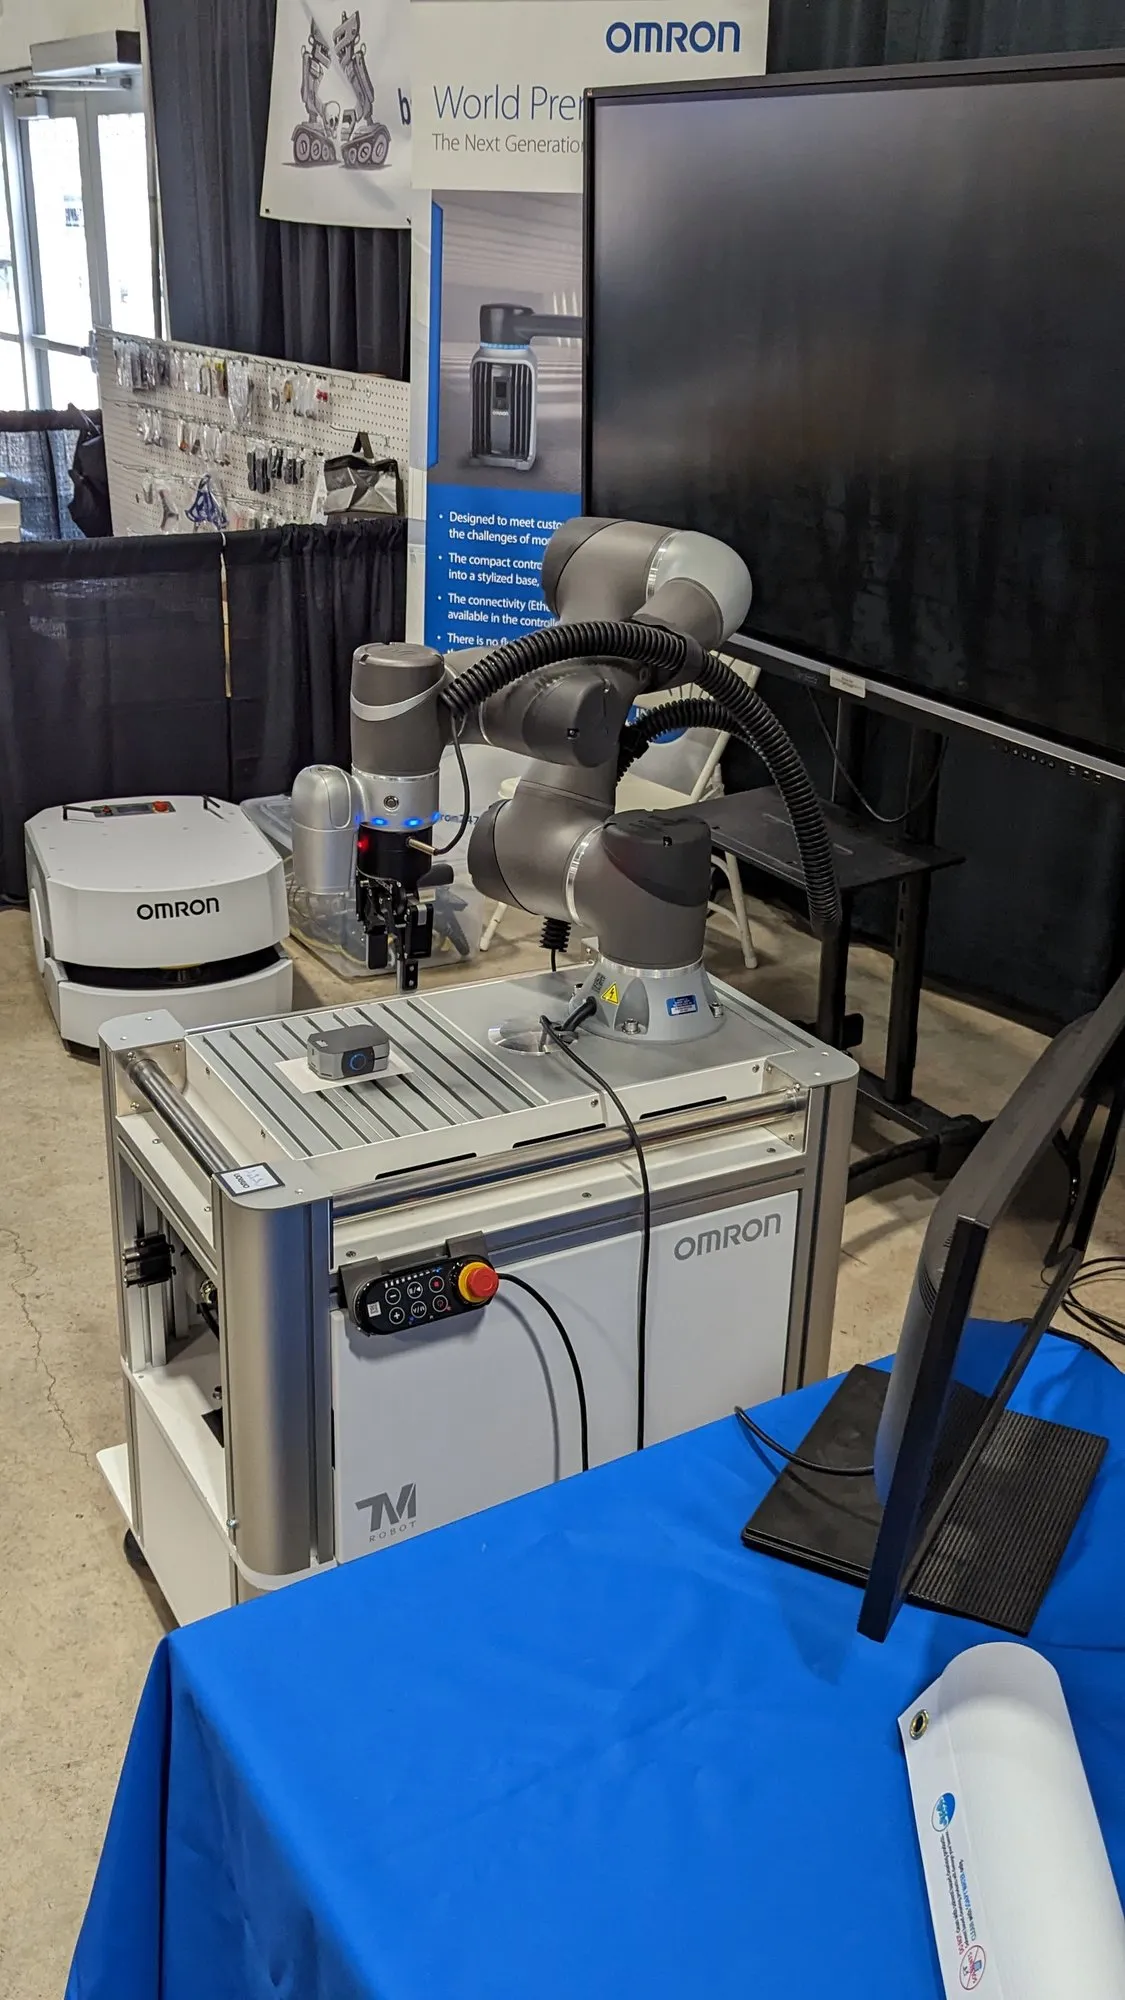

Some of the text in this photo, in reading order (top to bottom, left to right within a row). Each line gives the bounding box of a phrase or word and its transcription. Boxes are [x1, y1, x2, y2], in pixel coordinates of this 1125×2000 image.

[605, 21, 741, 54] OMRON
[433, 84, 520, 120] World
[432, 133, 460, 151] The
[465, 134, 501, 152] Next
[449, 511, 565, 530] Designed to meet custo
[448, 527, 465, 540] the
[467, 529, 518, 545] challenges
[519, 533, 531, 544] of
[448, 552, 467, 564] The
[468, 556, 511, 569] compact
[448, 568, 540, 588] into a stylized base,
[447, 592, 466, 605] The
[468, 596, 526, 612] connectivity
[447, 610, 489, 623] available
[490, 612, 500, 623] in
[502, 613, 518, 625] the
[447, 632, 475, 645] There
[476, 635, 483, 646] is
[486, 638, 499, 647] no
[136, 897, 220, 921] OMRON
[674, 1213, 782, 1261] OMRON
[355, 1482, 417, 1532] TM
[369, 1520, 417, 1543] ROBOT
